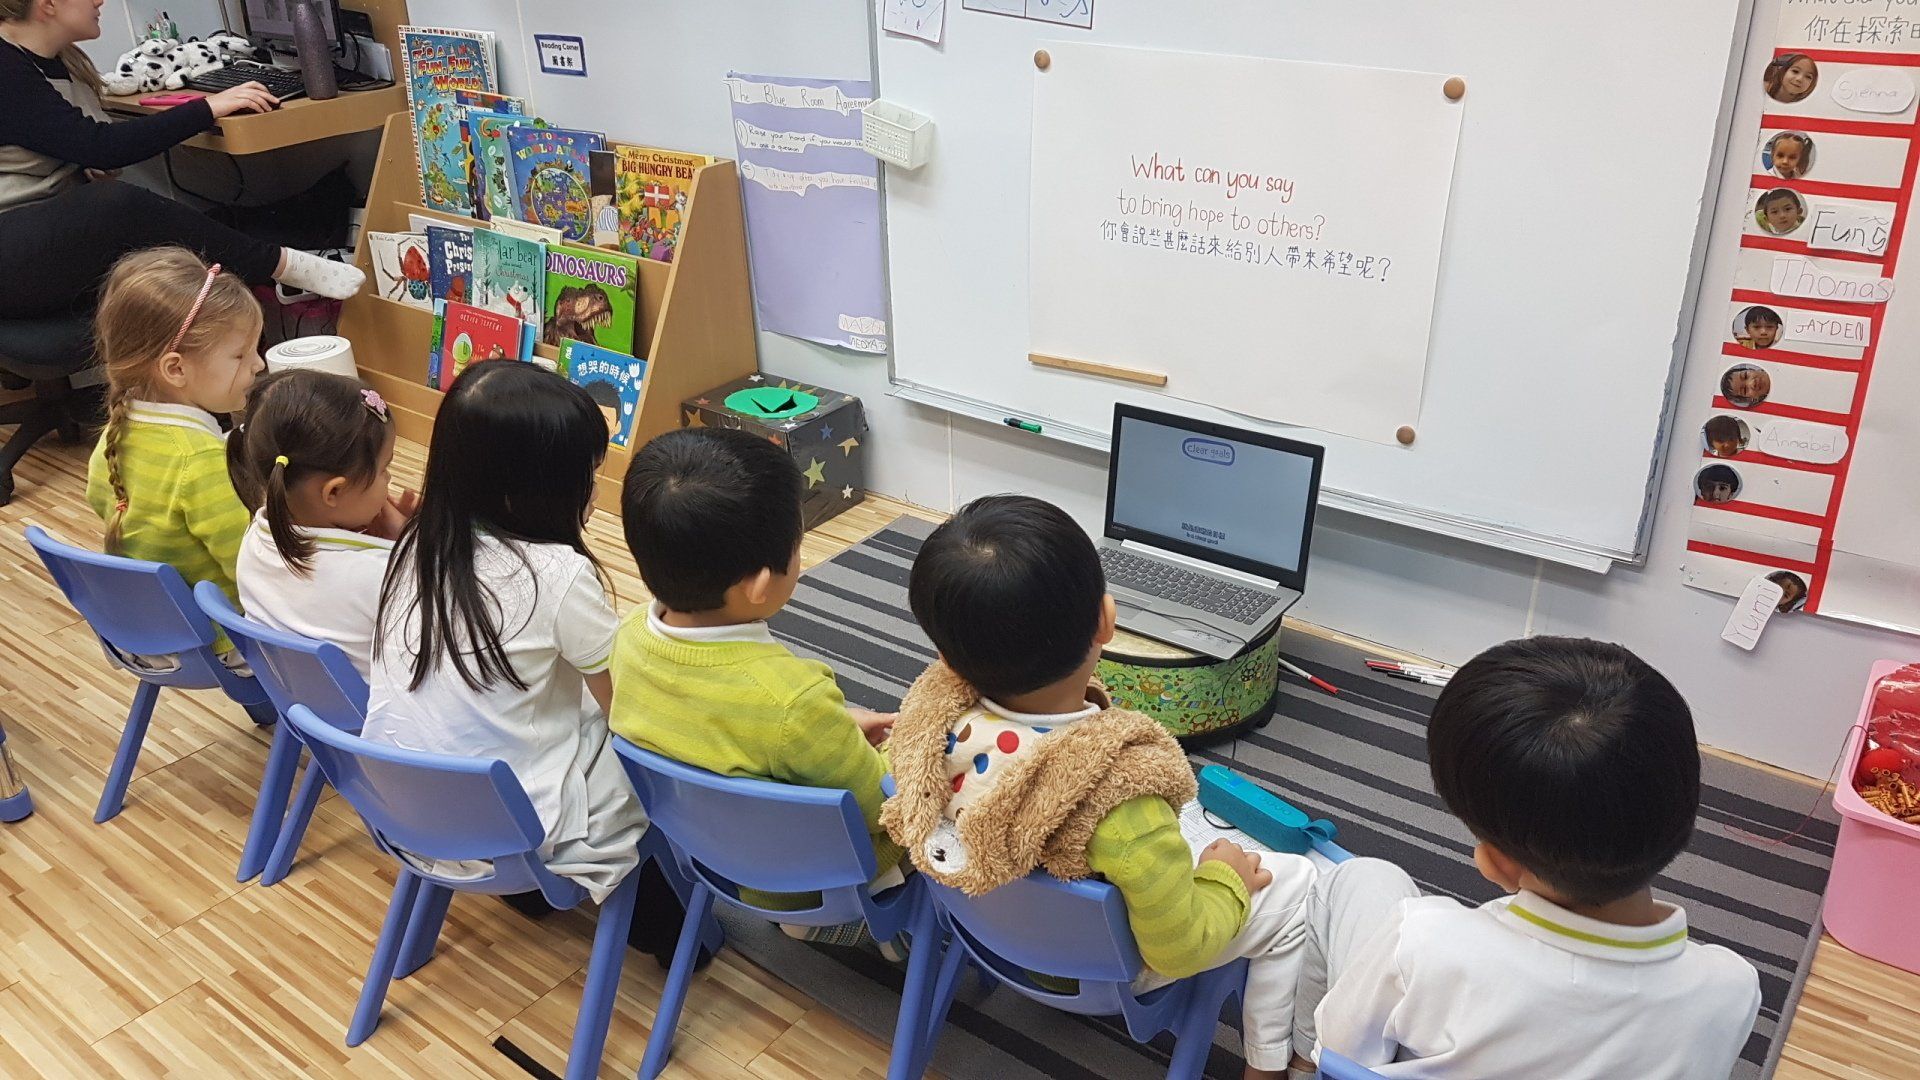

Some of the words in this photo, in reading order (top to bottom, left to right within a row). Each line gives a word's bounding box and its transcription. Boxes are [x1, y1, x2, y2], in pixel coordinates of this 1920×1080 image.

[541, 42, 561, 51] Reading
[447, 54, 472, 73] FUN
[433, 75, 481, 92] WORLD
[1838, 80, 1898, 100] Sienna
[764, 85, 786, 107] Blue
[801, 88, 825, 107] Room
[771, 132, 784, 144] your
[789, 133, 805, 142] hand
[820, 139, 832, 147] you
[516, 143, 554, 160] WORLD
[628, 150, 650, 162] Merry
[652, 154, 695, 167] Christmas,
[622, 160, 637, 173] BIG
[639, 161, 673, 178] HUNGRY
[675, 166, 695, 180] BEA
[1131, 152, 1185, 182] What
[1195, 167, 1220, 184] can
[1226, 172, 1259, 198] you
[1266, 176, 1294, 203] say
[1117, 189, 1137, 215] to
[1142, 194, 1182, 227] bring
[1189, 200, 1224, 231] hope
[1231, 206, 1250, 231] to
[1257, 212, 1325, 242] others?
[1811, 210, 1889, 252] Fung
[444, 241, 472, 260] Chris
[516, 241, 537, 266] bear
[546, 252, 626, 288] DINOSAURS
[1775, 258, 1890, 300] Thomas
[1796, 319, 1864, 341] JAYDEN
[1766, 427, 1837, 453] Annabel
[1187, 443, 1208, 454] clear
[1211, 448, 1231, 459] goals
[1724, 586, 1778, 641] Yumi
